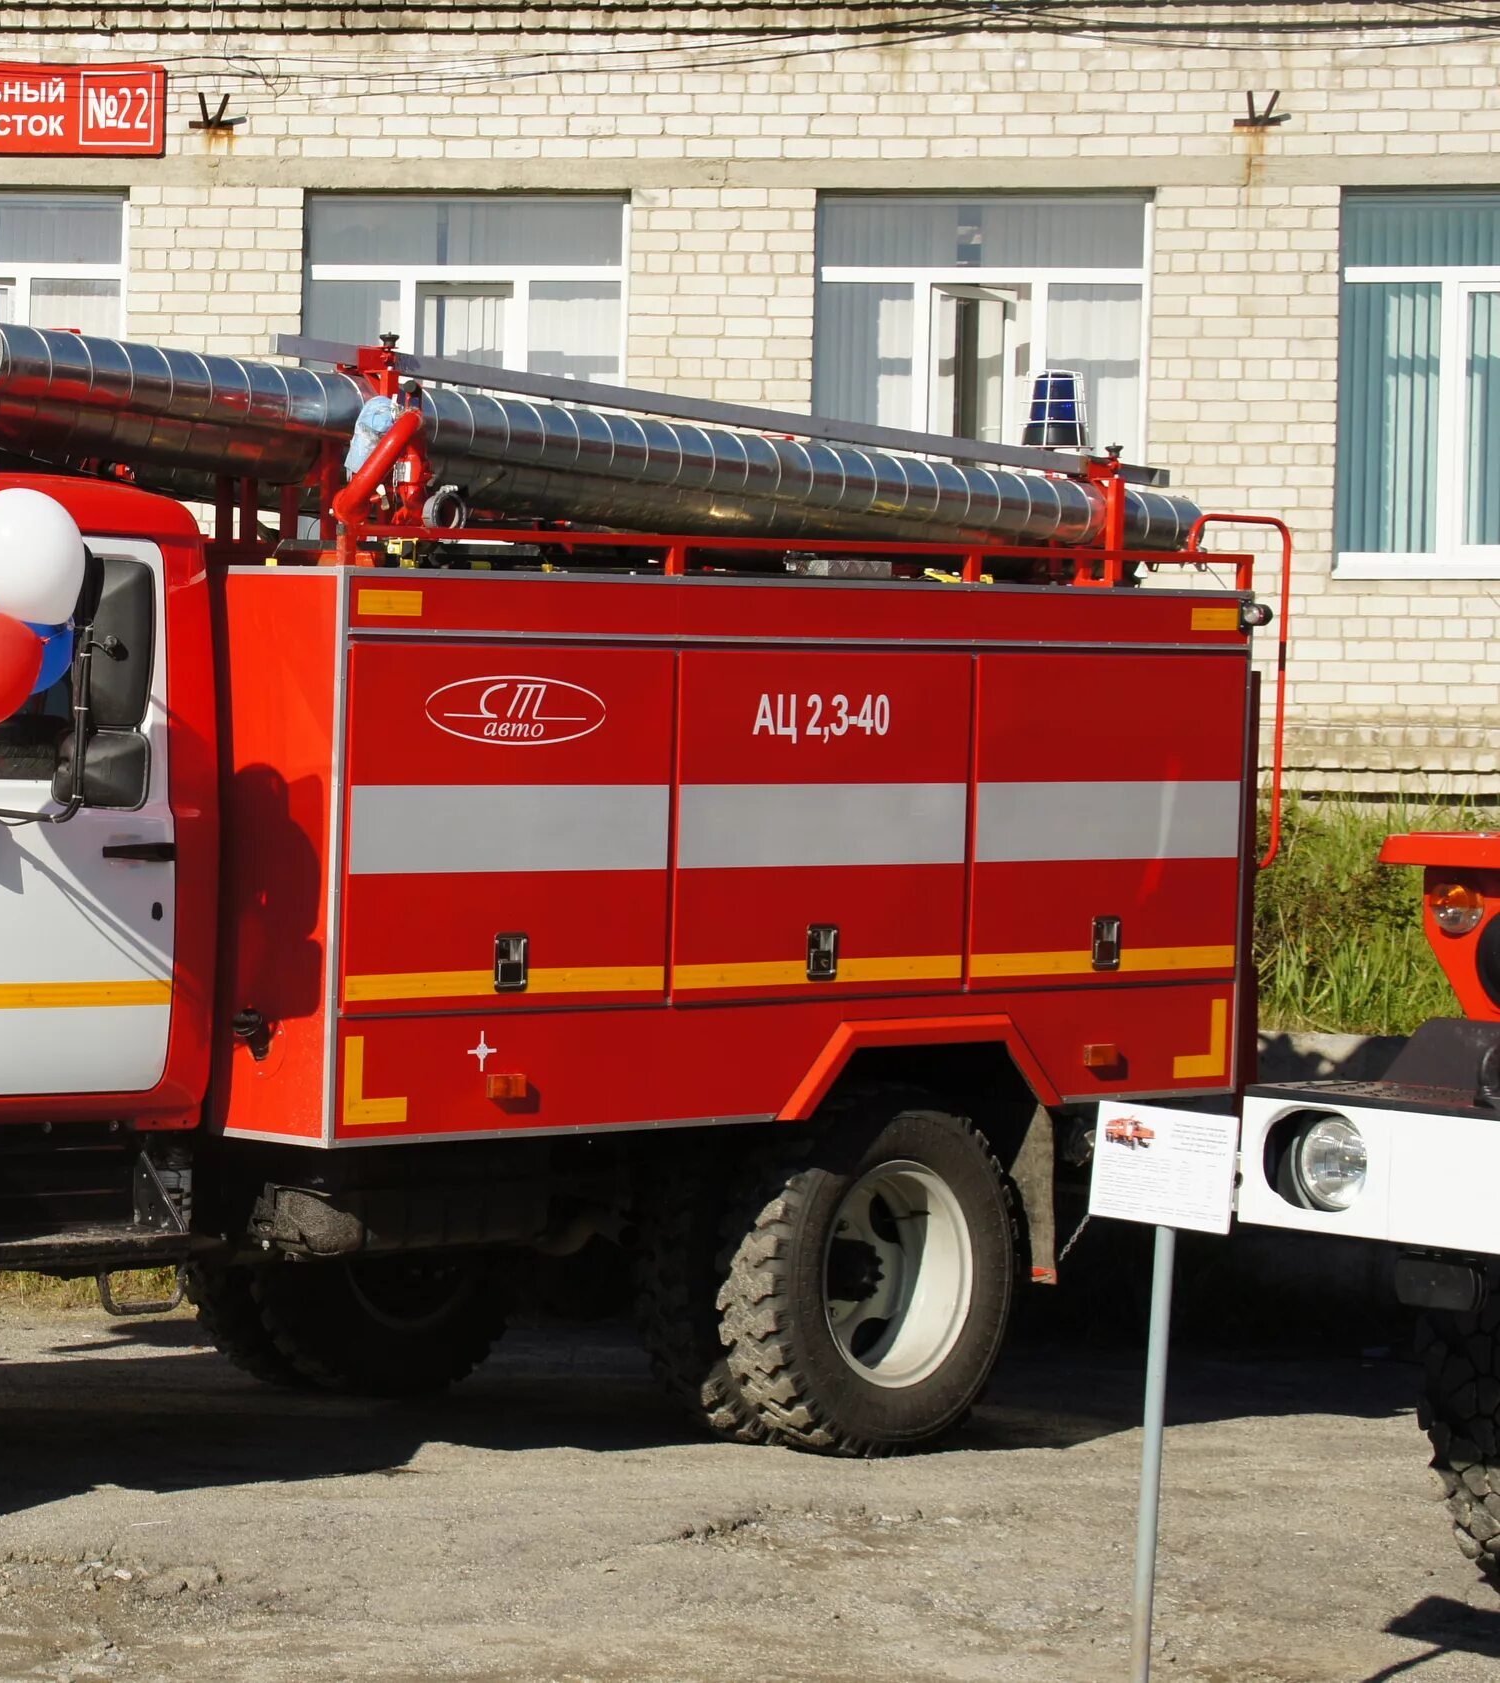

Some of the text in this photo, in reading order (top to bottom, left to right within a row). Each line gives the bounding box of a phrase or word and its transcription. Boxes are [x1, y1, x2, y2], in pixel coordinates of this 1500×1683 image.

[87, 86, 149, 130] №22
[483, 721, 544, 738] авто
[752, 693, 890, 744] АЦ 2,3-40
